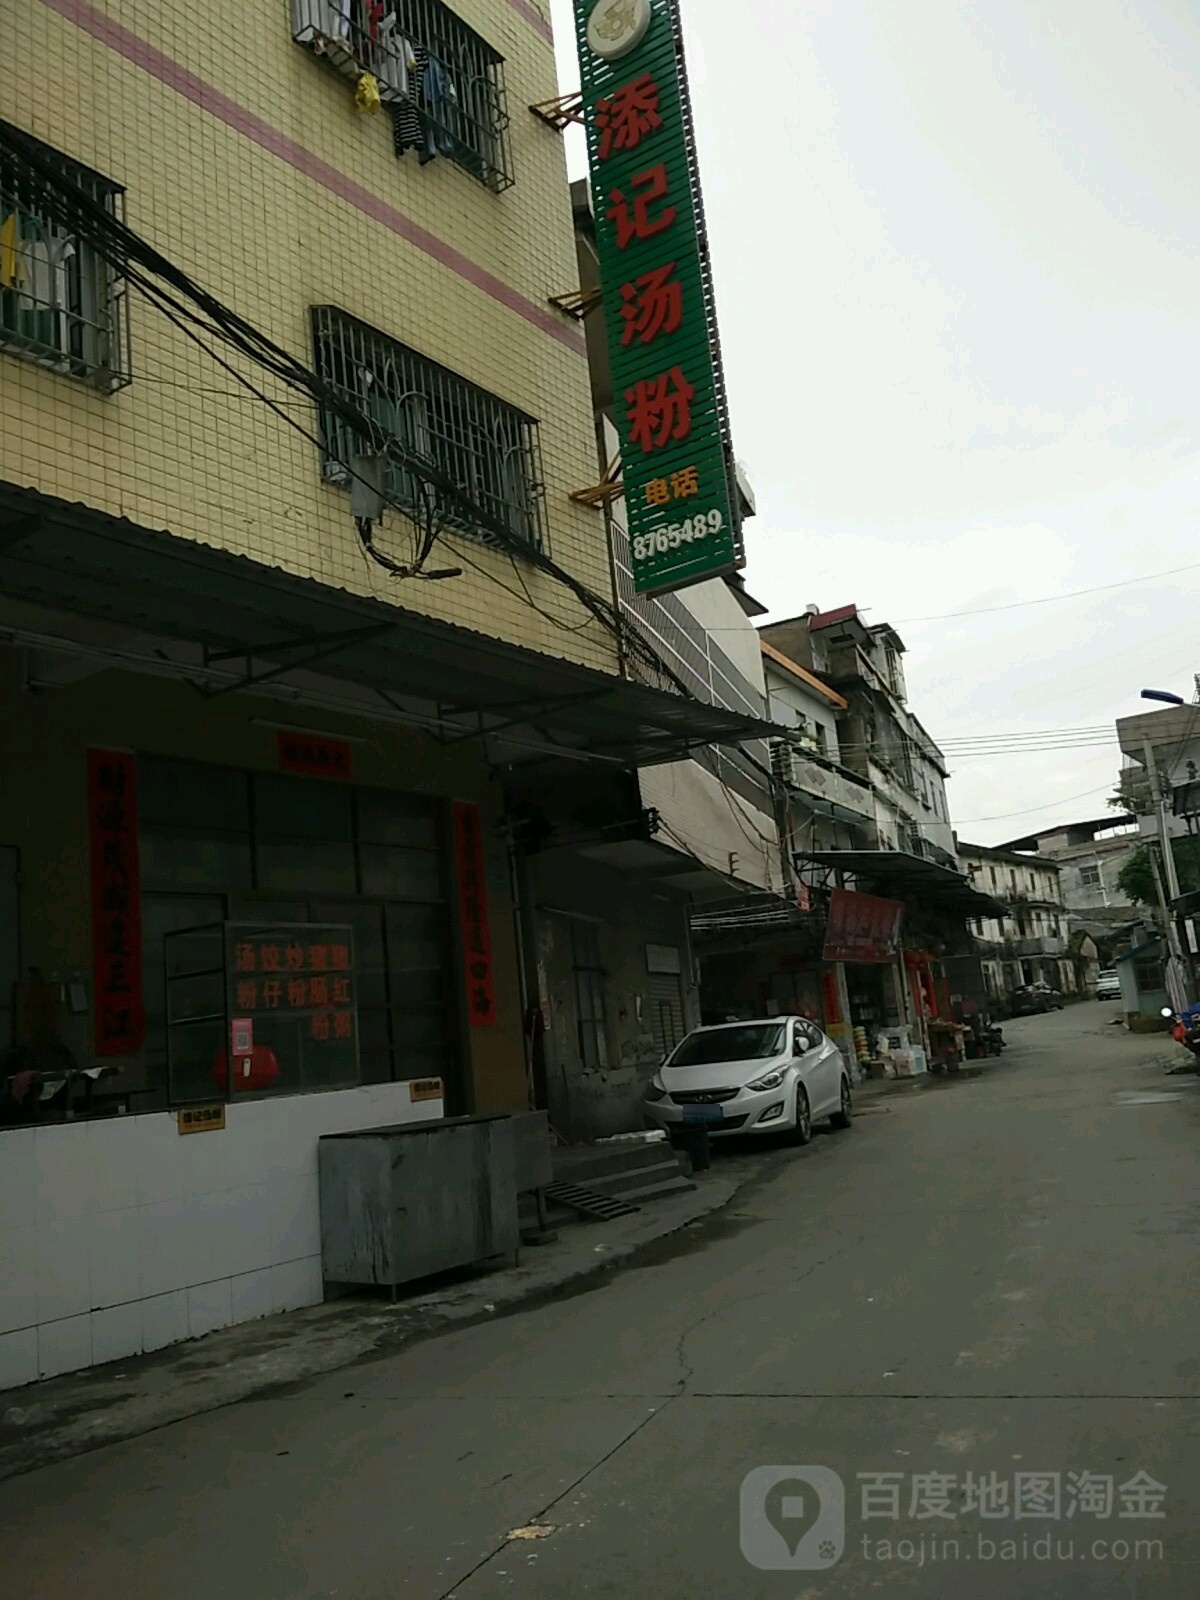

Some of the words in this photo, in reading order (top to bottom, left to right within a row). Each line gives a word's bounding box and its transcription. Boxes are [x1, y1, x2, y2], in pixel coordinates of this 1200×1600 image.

[594, 72, 696, 453] 添记汤粉
[645, 465, 700, 505] 电话
[633, 508, 722, 561] 8765489
